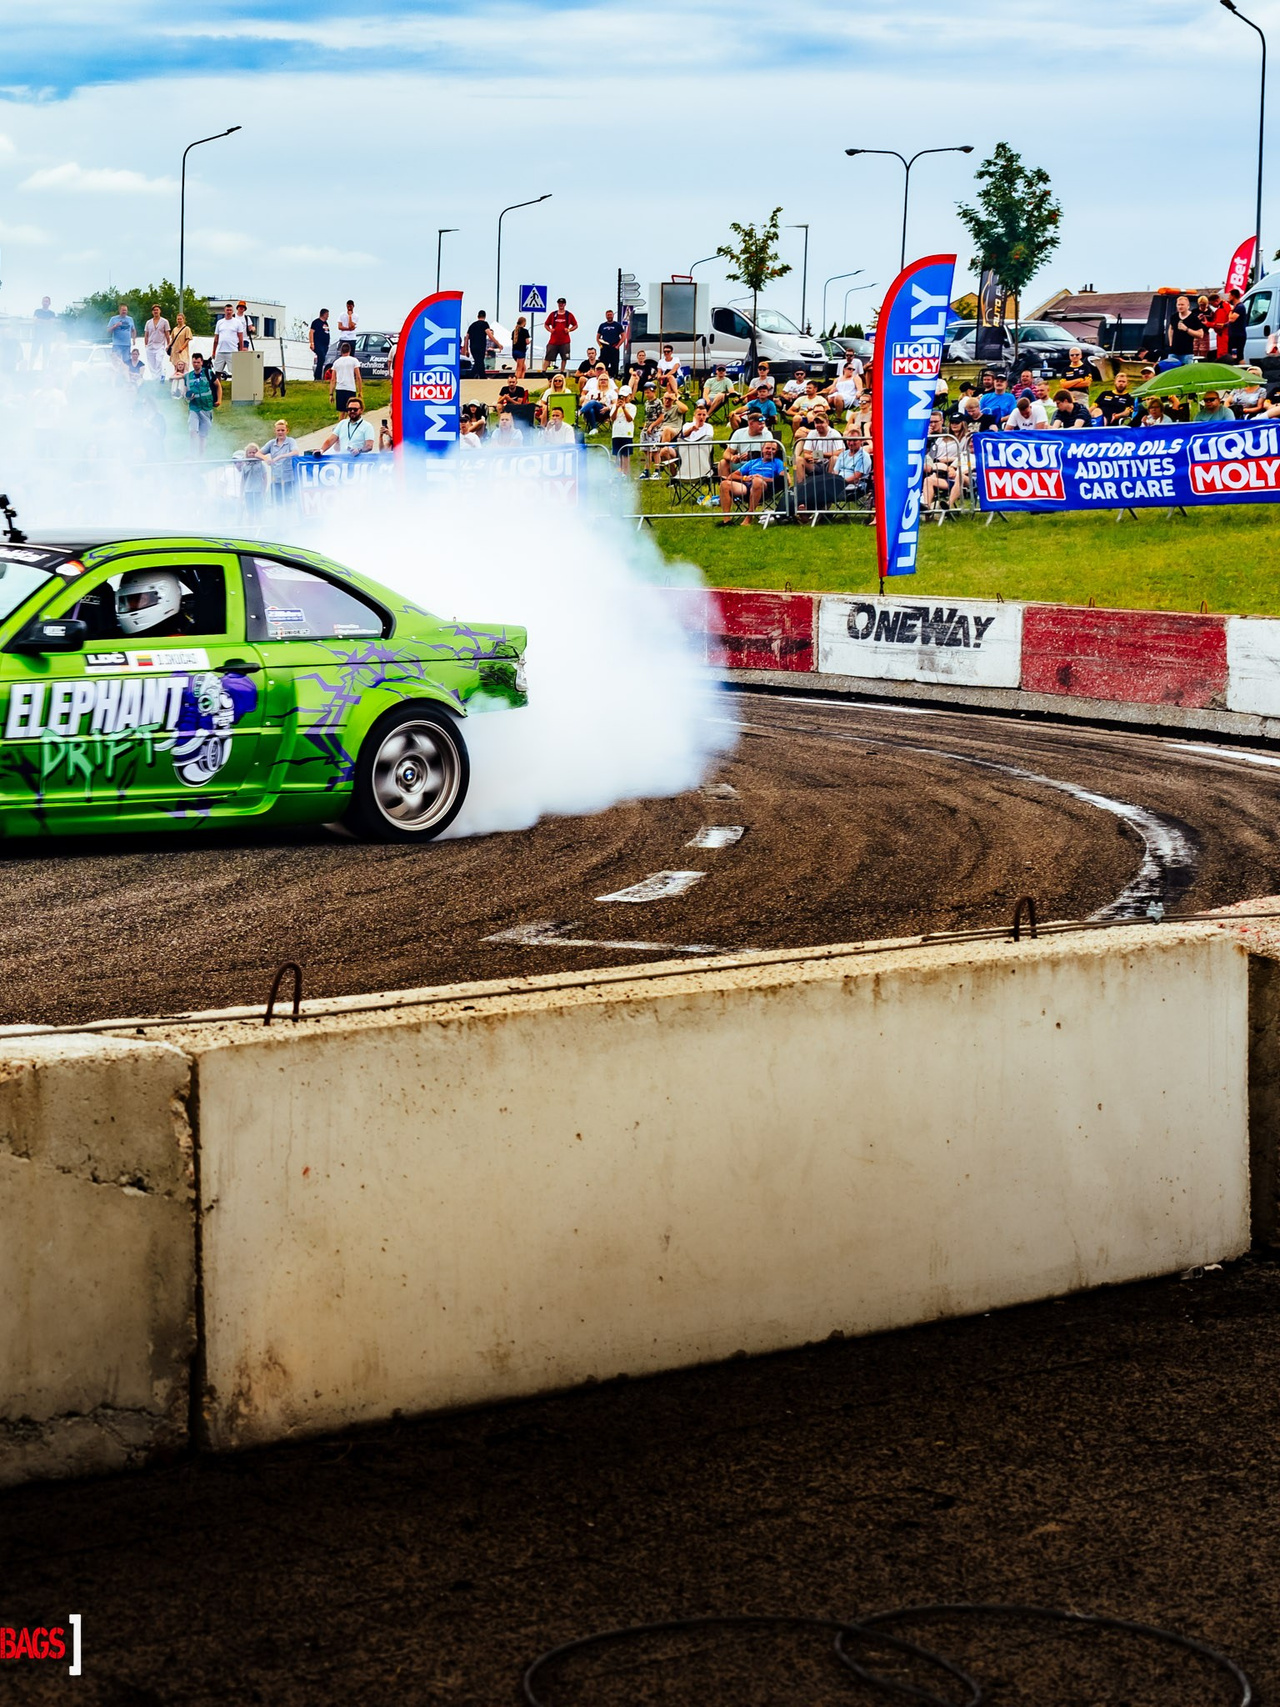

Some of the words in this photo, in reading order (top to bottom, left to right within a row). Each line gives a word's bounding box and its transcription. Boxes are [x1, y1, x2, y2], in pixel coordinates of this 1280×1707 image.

[993, 298, 1002, 327] AUTO
[895, 343, 940, 359] LIQUI
[412, 372, 451, 386] LIQUI
[895, 359, 939, 374] MOLY
[412, 386, 452, 399] MOLY
[985, 442, 1058, 470] LIQUI
[1067, 443, 1137, 459] MOTOR
[1138, 438, 1184, 456] OILS
[1192, 427, 1279, 461] LIQUI
[301, 463, 369, 488] LIQUI
[498, 453, 573, 478] LIQUI
[1074, 458, 1175, 479] ADDITIVES
[1193, 459, 1280, 492] MOLY
[988, 471, 1059, 497] MOLY
[1079, 482, 1119, 500] CAR
[1121, 479, 1176, 498] CARE
[897, 438, 925, 568] LIQUI
[5, 676, 189, 738] ELEPHANT
[40, 722, 161, 793] DRIFT
